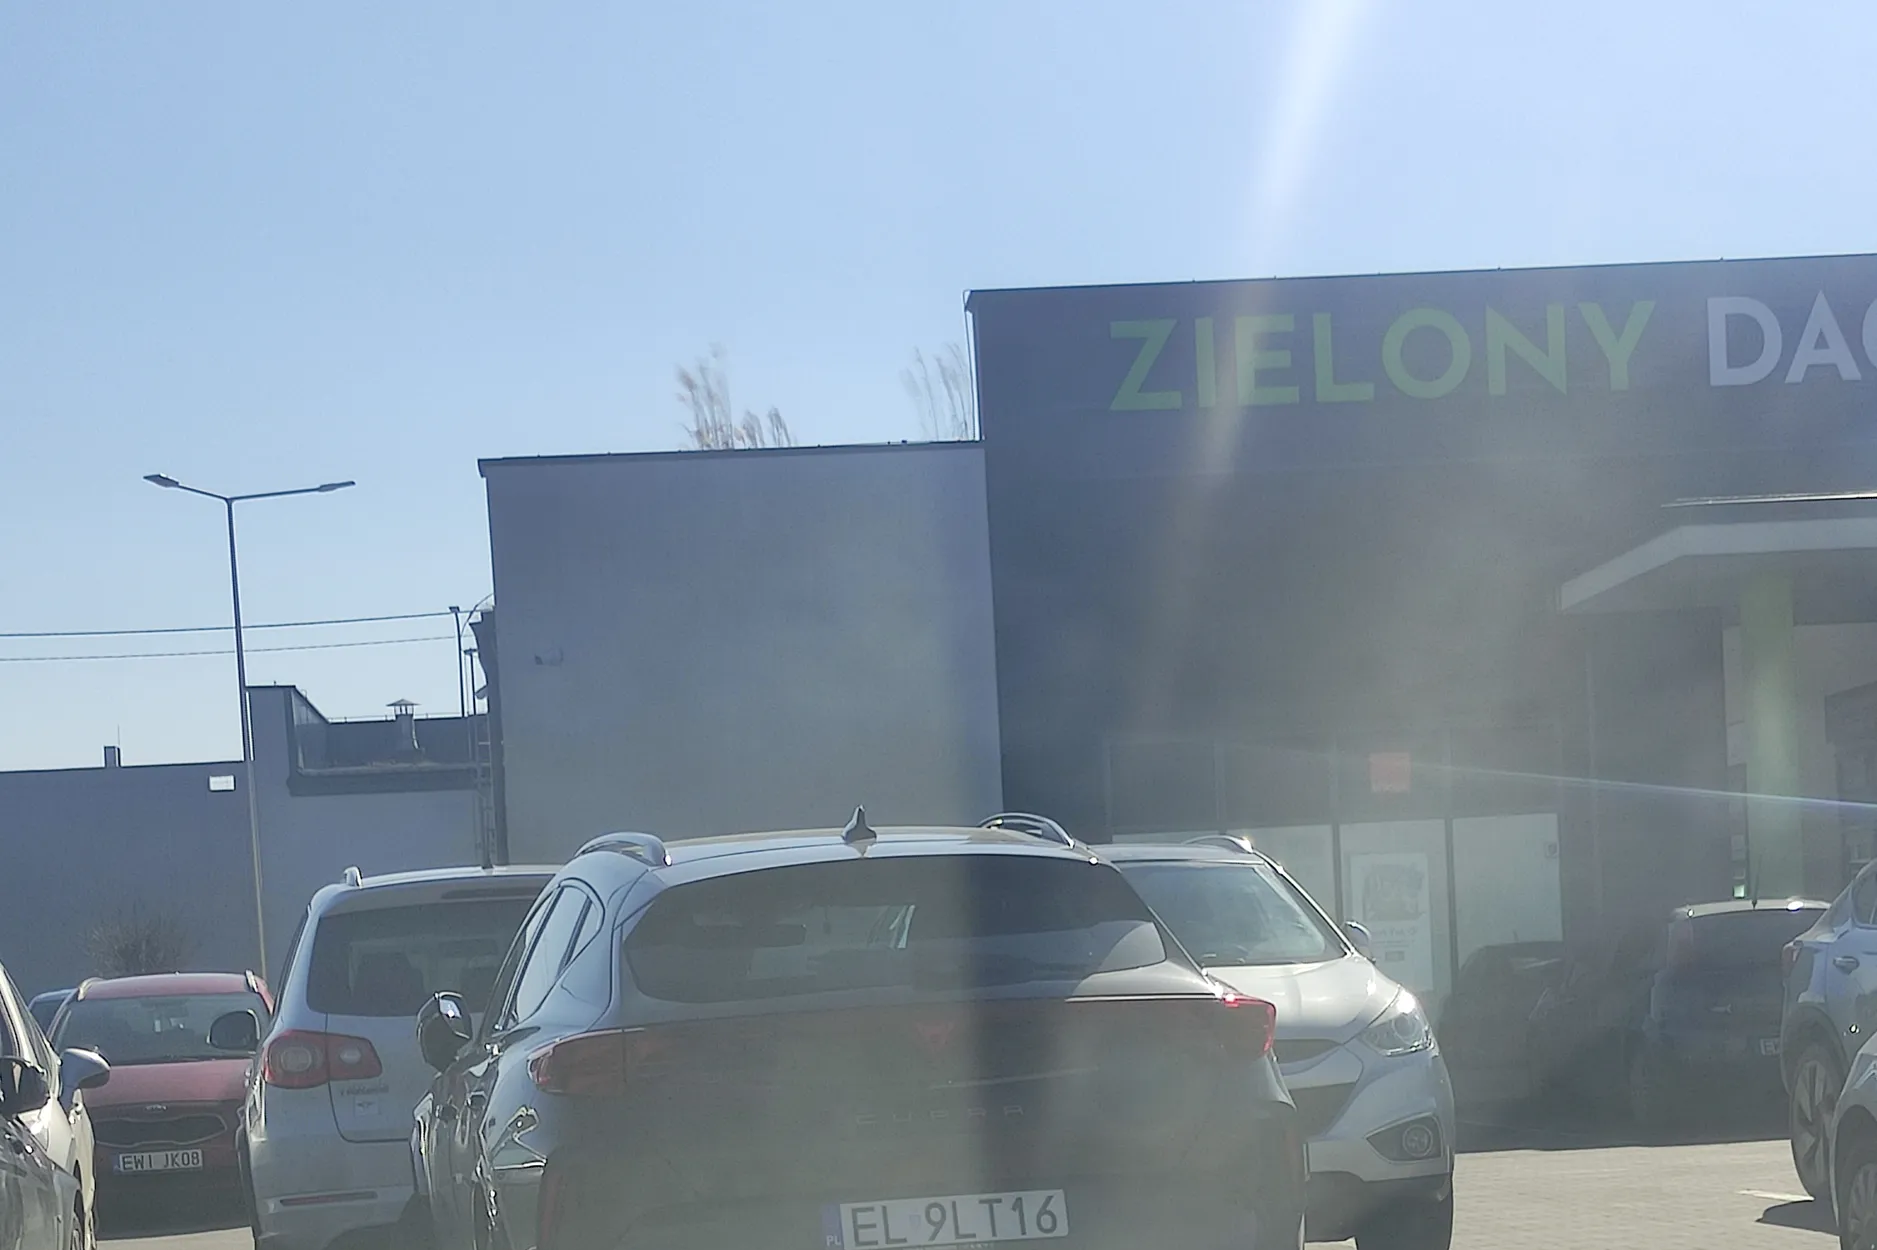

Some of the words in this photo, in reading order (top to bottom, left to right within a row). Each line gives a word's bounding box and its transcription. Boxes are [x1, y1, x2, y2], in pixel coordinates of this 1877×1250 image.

[1109, 301, 1657, 411] ZIELONY
[1707, 290, 1877, 388] DA
[121, 1154, 152, 1171] EWI
[851, 1204, 908, 1247] EL
[924, 1195, 1059, 1242] 9LT16
[826, 1234, 843, 1248] PL
